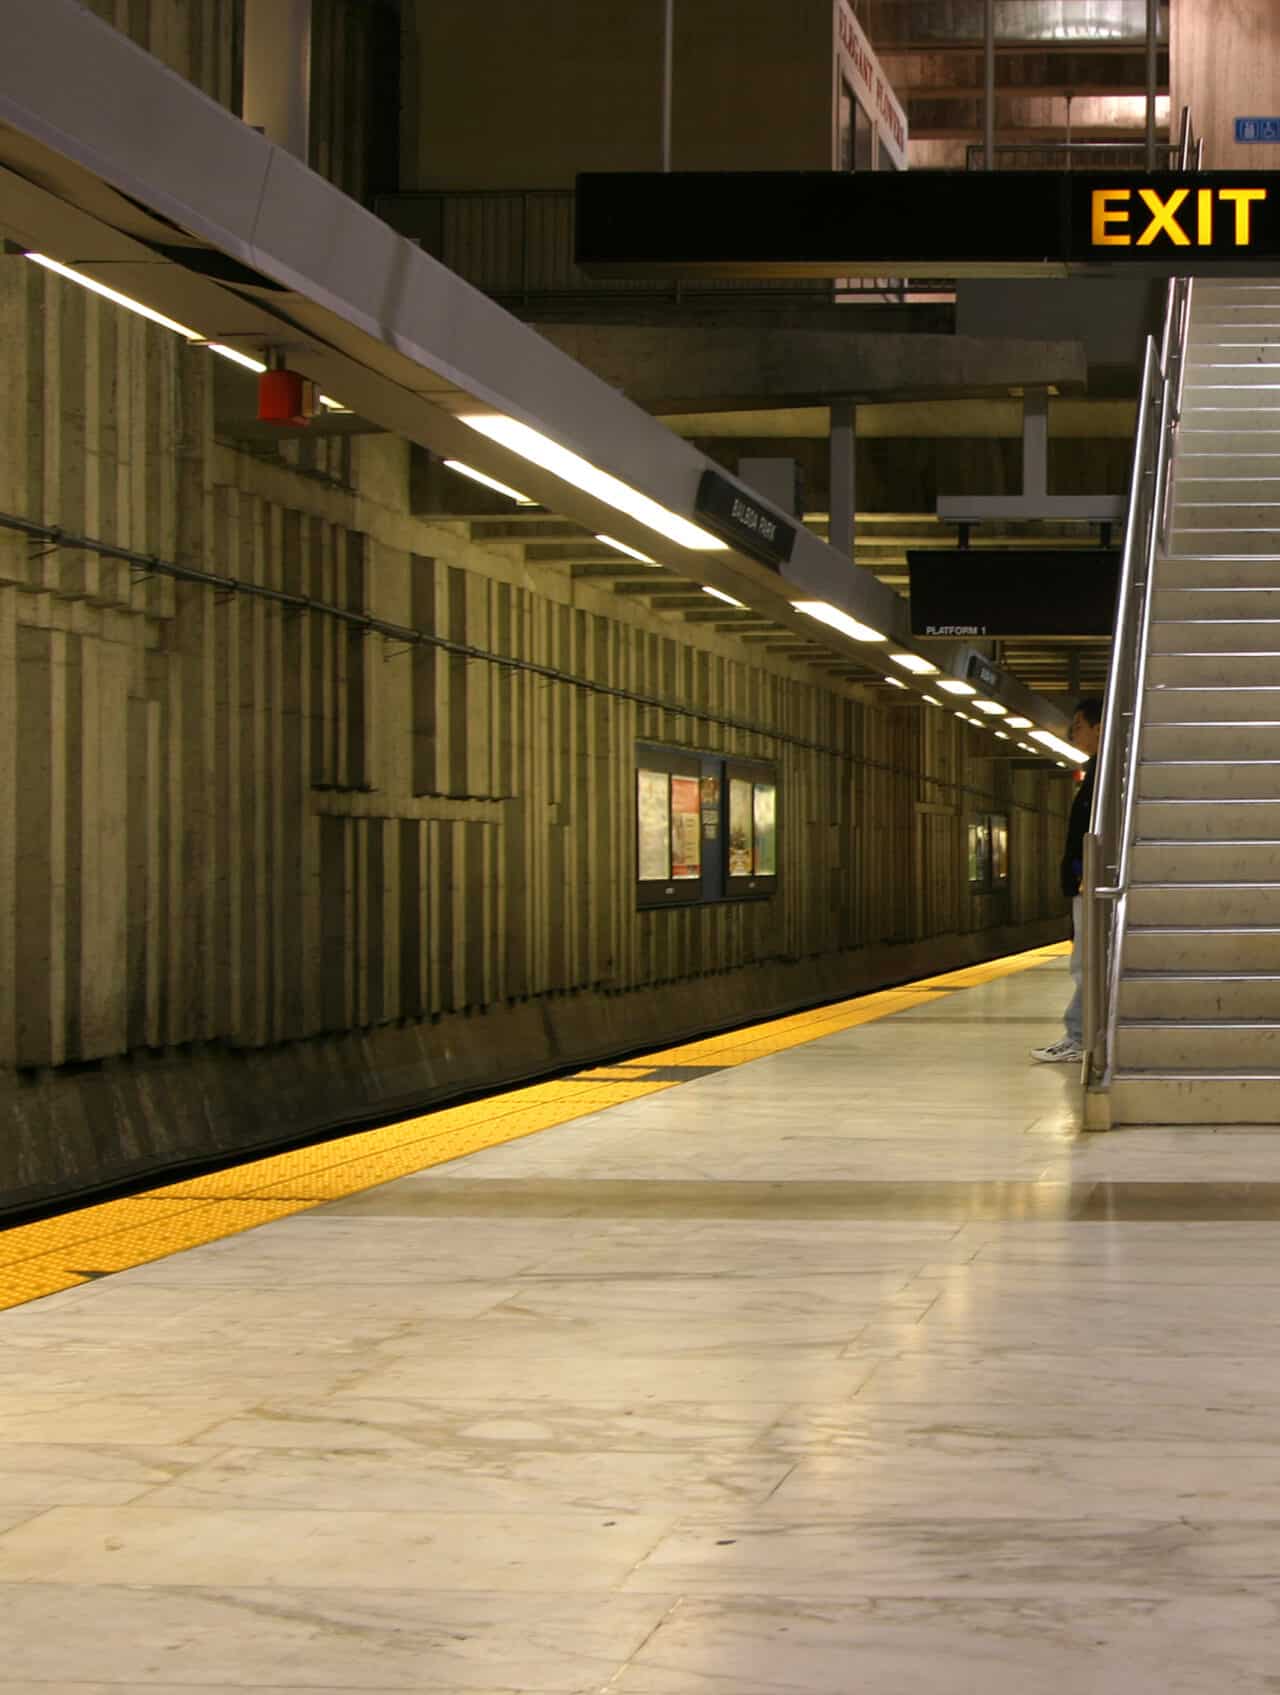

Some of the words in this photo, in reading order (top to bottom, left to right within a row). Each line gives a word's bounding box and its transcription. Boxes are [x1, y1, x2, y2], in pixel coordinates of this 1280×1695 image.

[1091, 188, 1267, 246] EXIT
[759, 515, 777, 542] PARK
[926, 625, 978, 635] PLATFORM
[981, 626, 986, 635] 1
